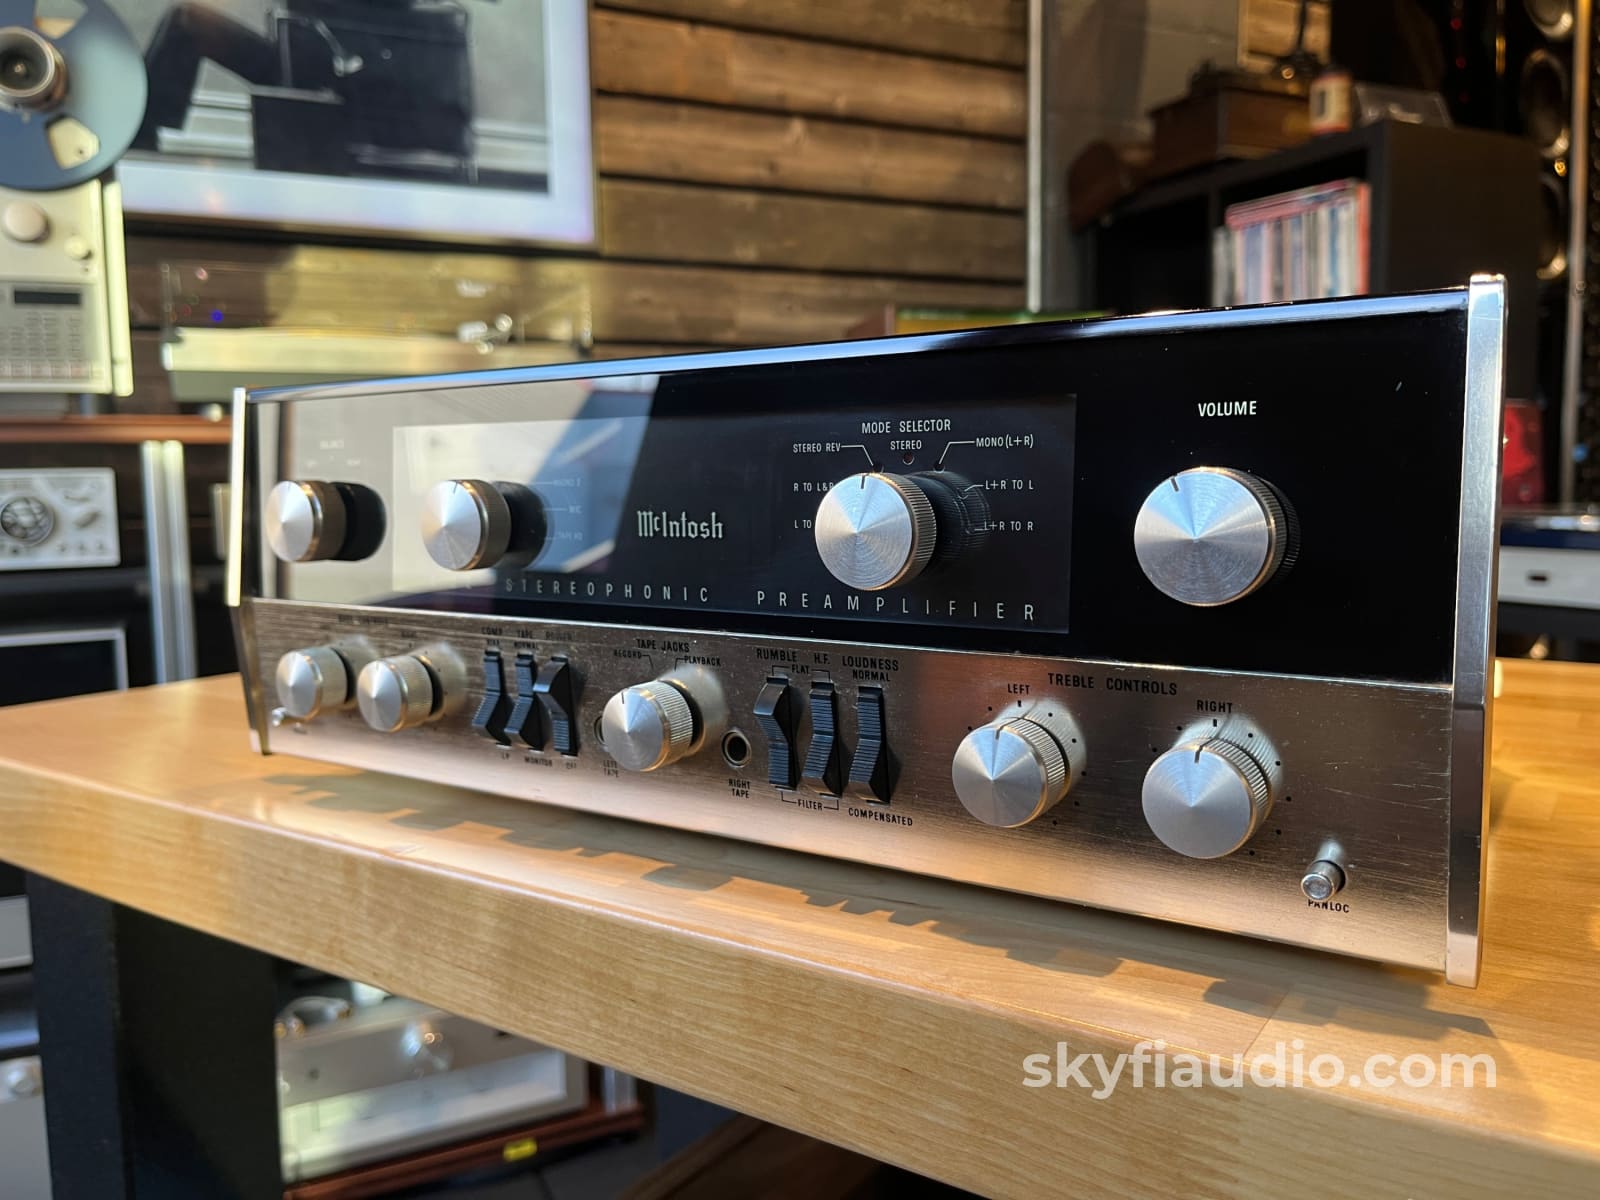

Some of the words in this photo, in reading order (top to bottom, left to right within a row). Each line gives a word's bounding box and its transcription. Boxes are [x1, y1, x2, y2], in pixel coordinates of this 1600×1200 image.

[1197, 401, 1257, 417] VOLUME
[861, 421, 891, 434] MODE
[899, 419, 952, 432] SELECTOR
[792, 442, 822, 453] STEREO
[825, 442, 841, 452] REV
[890, 440, 923, 451] STEREO
[793, 483, 799, 492] R
[802, 482, 813, 492] TO
[985, 479, 1007, 490] L+R
[1012, 479, 1025, 490] TO
[1028, 479, 1034, 490] L
[637, 510, 724, 539] McIntosh
[794, 519, 799, 529] L
[803, 519, 812, 529] TO
[984, 520, 1005, 531] L+R
[1010, 520, 1022, 531] TO
[1027, 520, 1034, 531] R
[506, 579, 709, 602] STEREOPHONIC
[757, 590, 1035, 621] PREAMPLIFIER
[636, 639, 656, 650] TAPE
[661, 641, 690, 653] JACKS
[684, 655, 721, 666] PLAYBACK
[756, 648, 798, 662] RUMBLE
[814, 653, 830, 665] H.F.
[842, 656, 899, 671] LOUDNESS
[791, 665, 809, 675] FLAT
[852, 670, 891, 682] NORMAL
[1007, 684, 1030, 695] LEFT
[1048, 673, 1095, 689] TREBLE
[1106, 678, 1178, 696] CONTROLS
[1197, 700, 1233, 713] RIGHT
[729, 778, 751, 790] RIGHT
[732, 788, 750, 798] TAPE
[798, 799, 823, 811] FILTER
[848, 807, 913, 826] COMPENSATED
